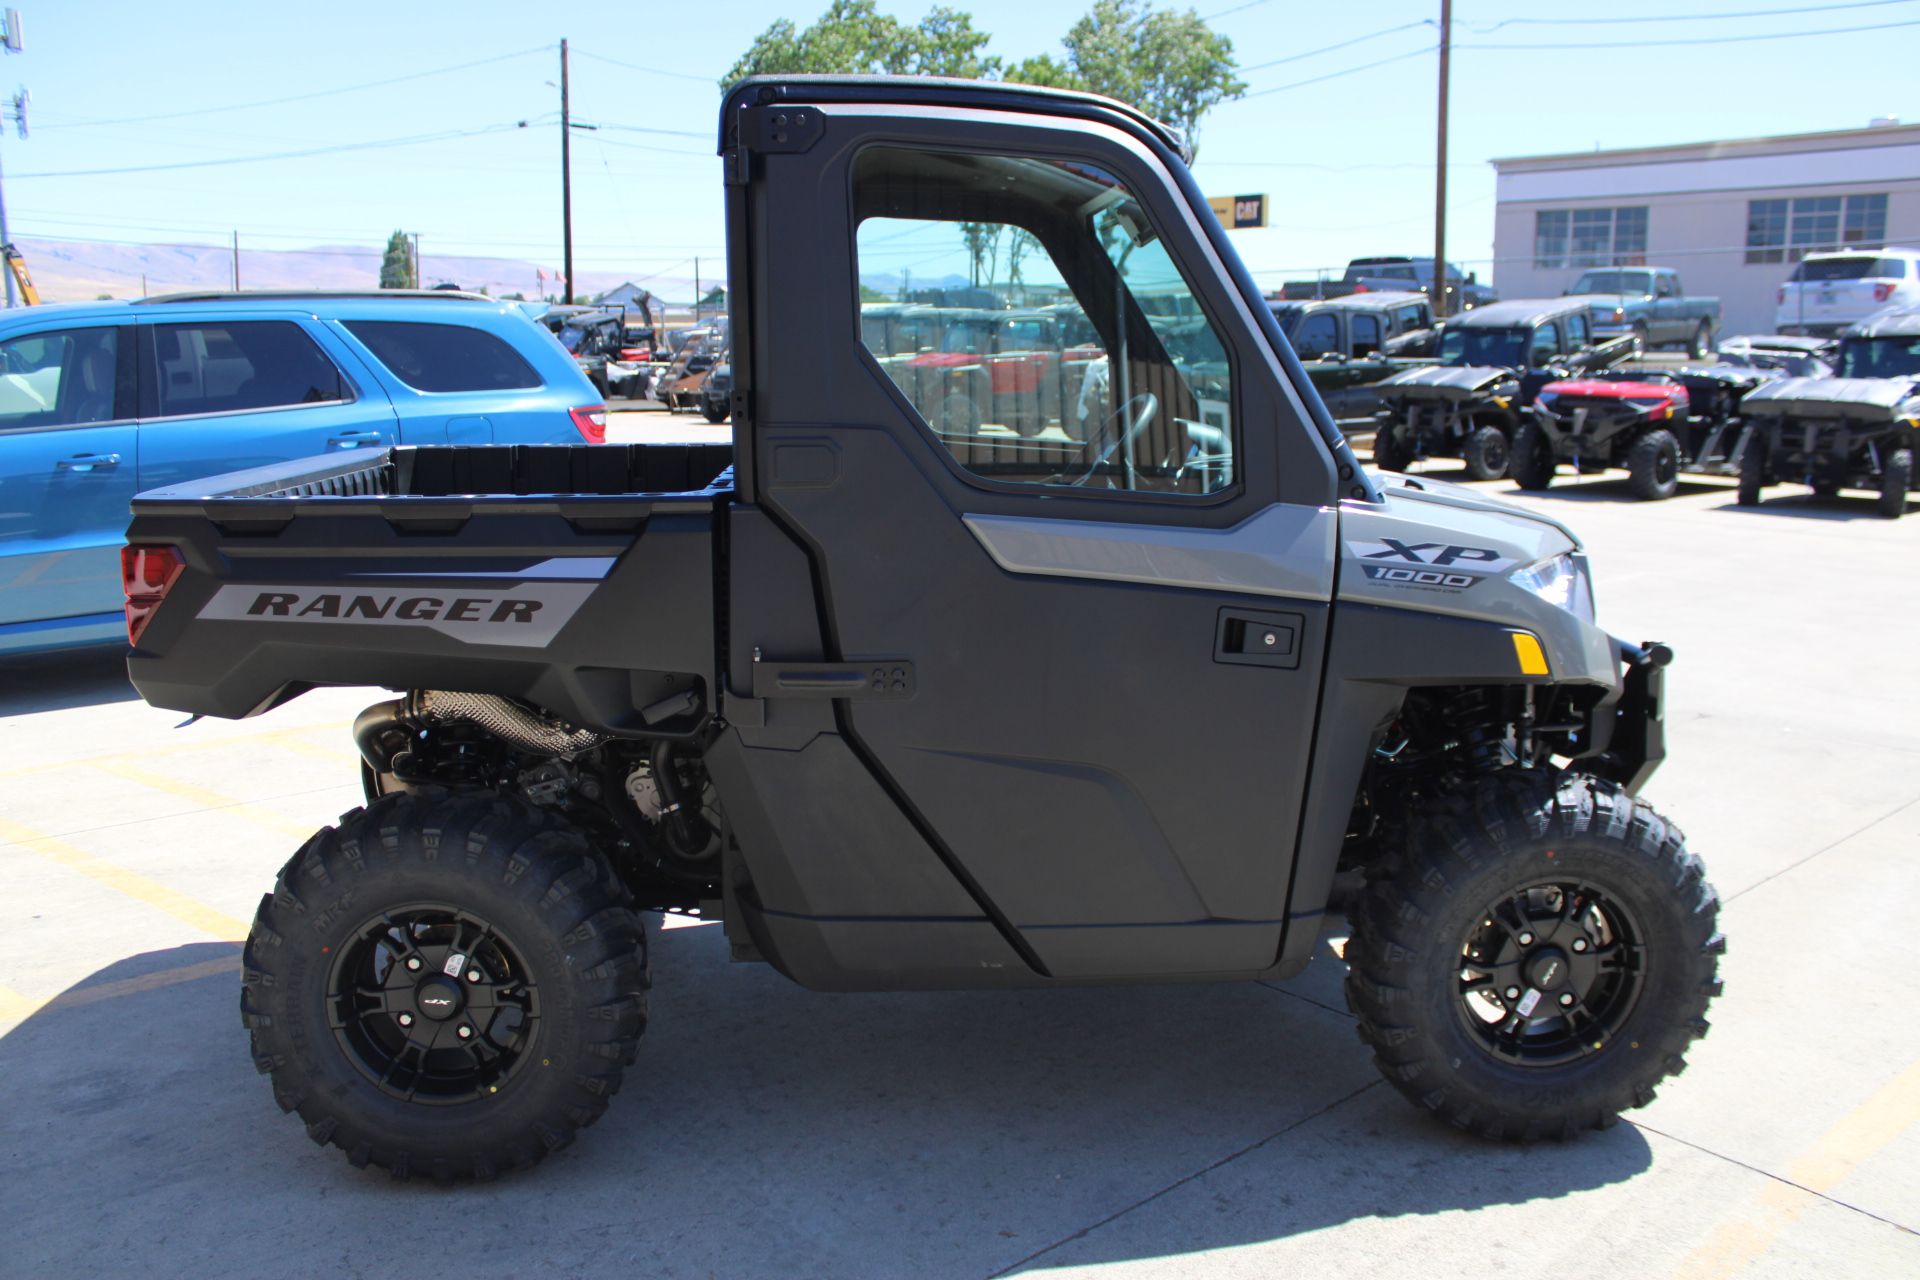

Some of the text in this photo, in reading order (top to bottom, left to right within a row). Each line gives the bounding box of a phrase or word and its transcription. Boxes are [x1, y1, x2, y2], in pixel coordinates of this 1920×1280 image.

[1236, 201, 1260, 221] CAT
[1361, 538, 1500, 566] XP
[1375, 567, 1473, 588] 1000
[246, 592, 544, 624] RANGER
